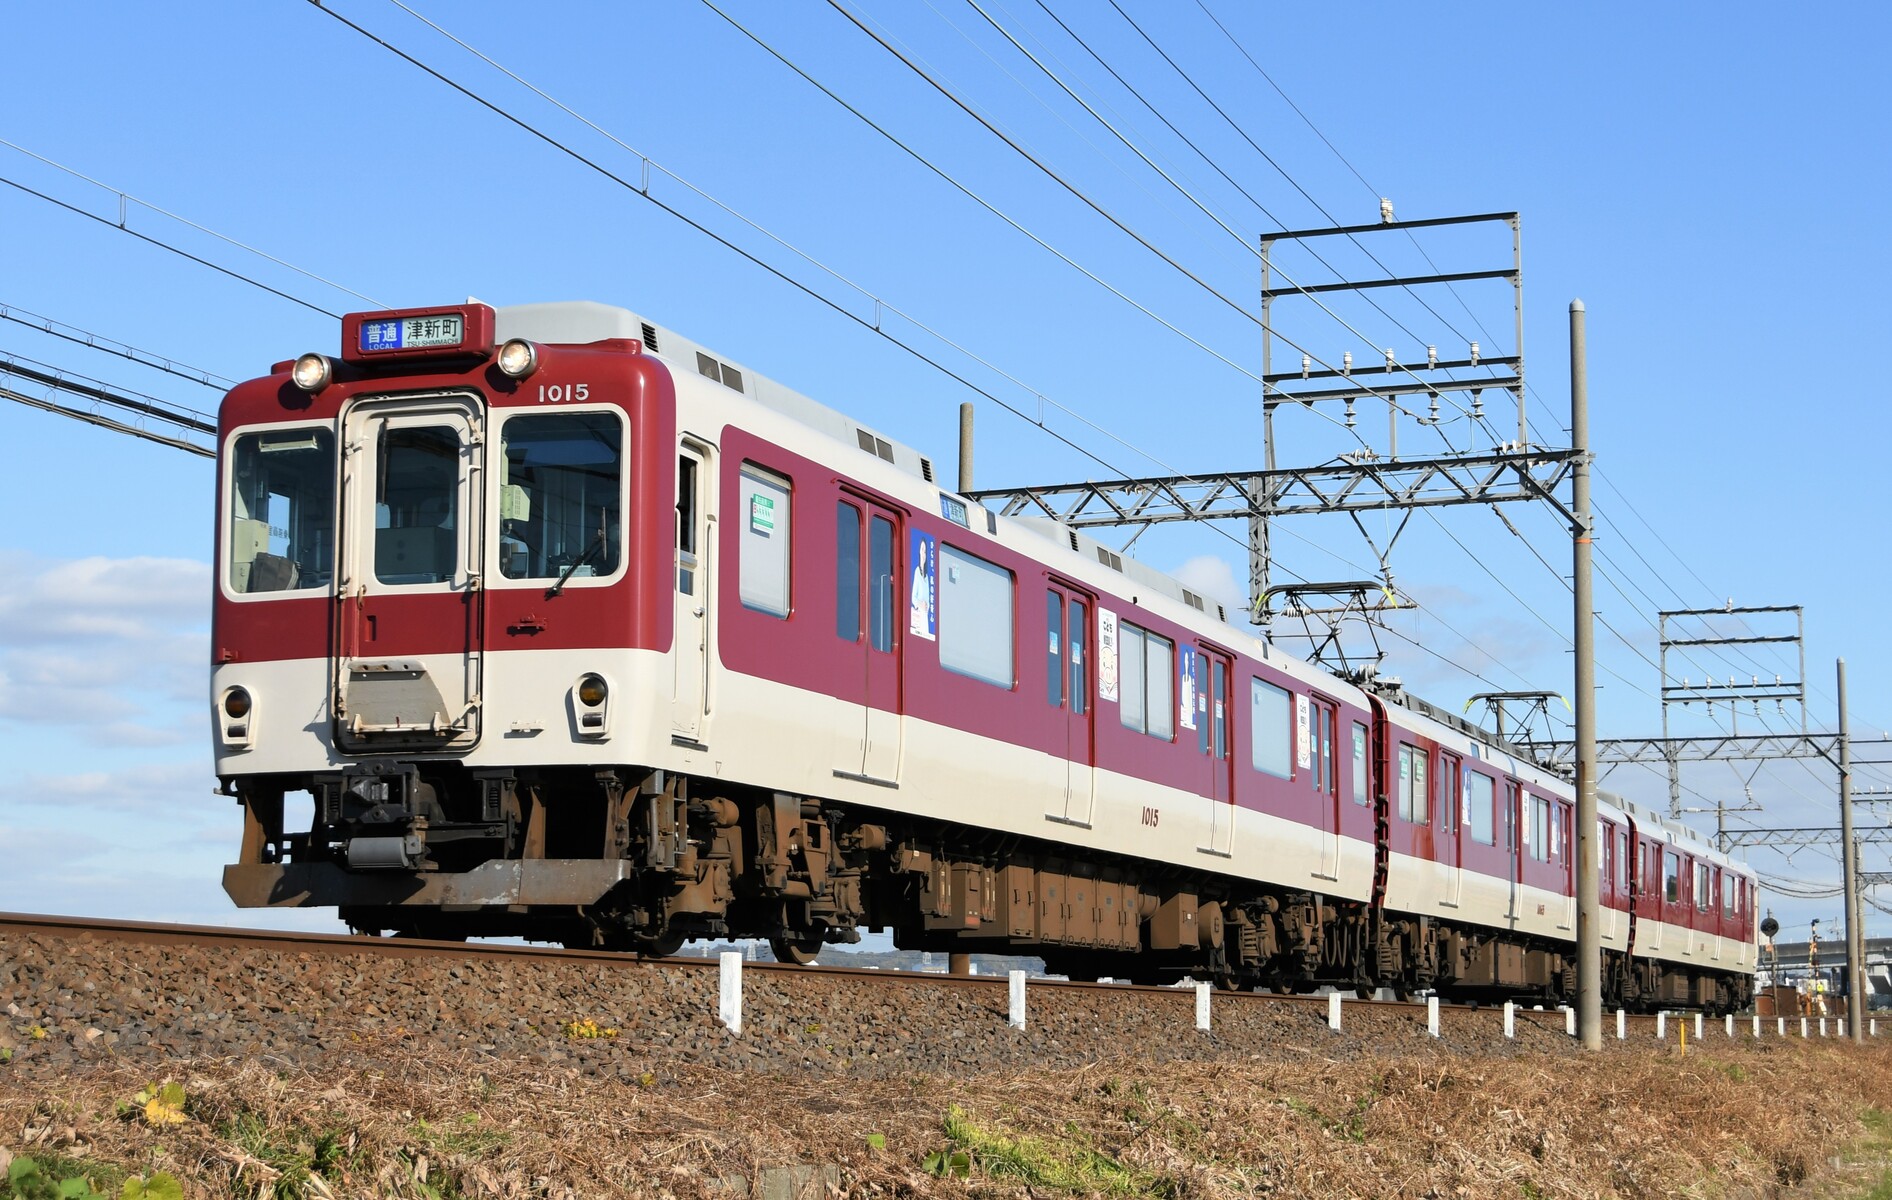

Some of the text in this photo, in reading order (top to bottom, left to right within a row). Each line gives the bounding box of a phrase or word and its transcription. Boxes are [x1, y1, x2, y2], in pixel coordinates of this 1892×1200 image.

[367, 323, 397, 343] 普通
[407, 319, 458, 340] 津新町
[538, 383, 589, 403] 1015
[1141, 806, 1159, 828] 1015
